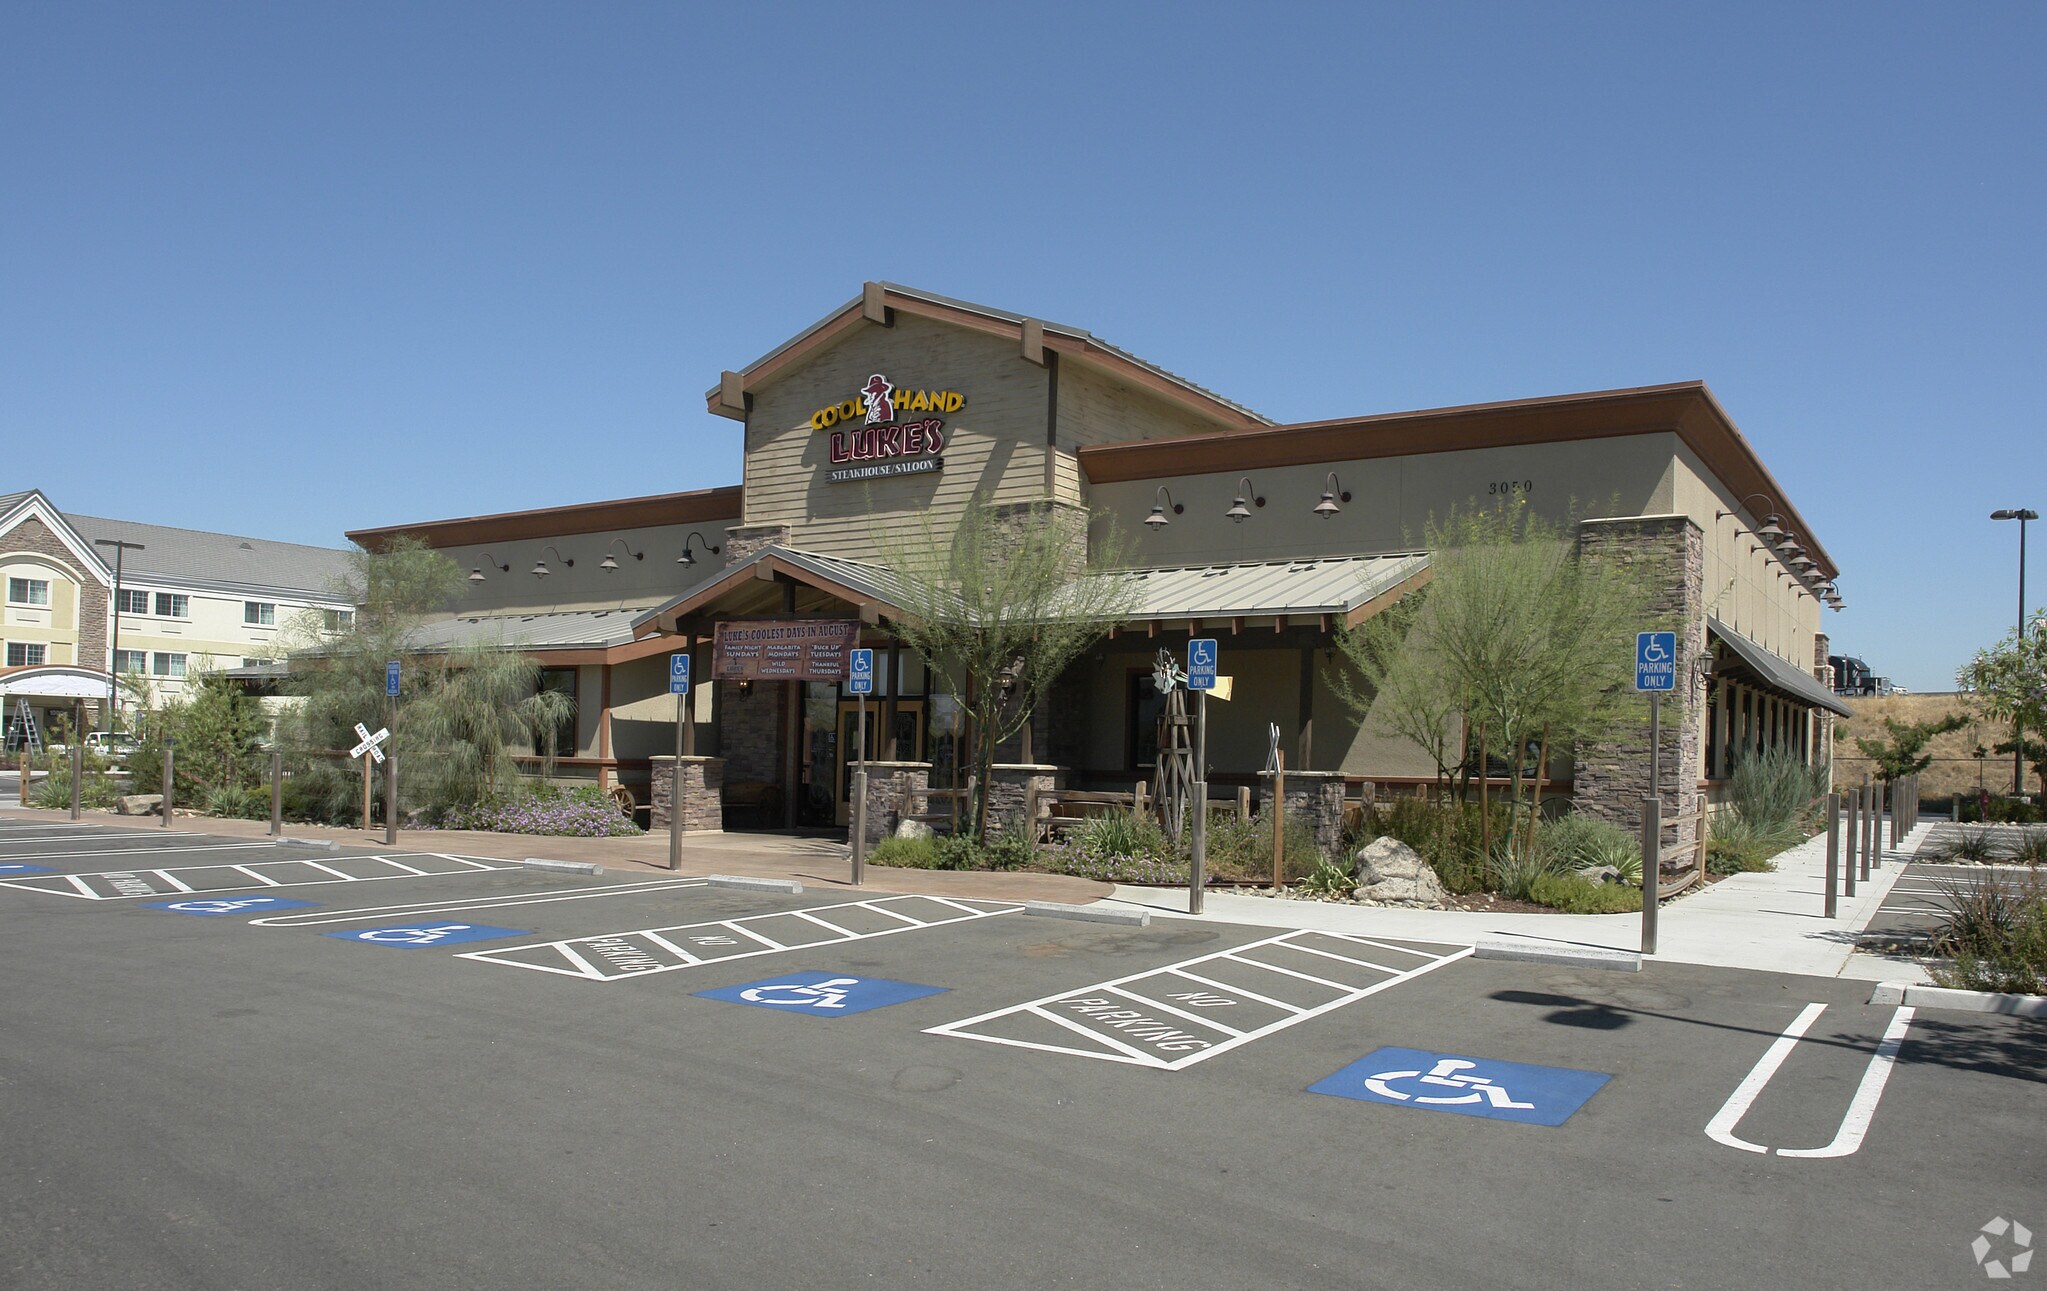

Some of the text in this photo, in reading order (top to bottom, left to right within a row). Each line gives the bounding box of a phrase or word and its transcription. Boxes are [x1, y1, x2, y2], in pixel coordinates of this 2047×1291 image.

[811, 389, 963, 430] COOL HAND
[831, 418, 945, 464] LUKE'S
[831, 460, 934, 480] STEAKHOUSE/SALOON
[1489, 480, 1532, 495] 3050
[724, 624, 849, 642] LUKE'S COOLEST DAYS IN AUGUST
[1190, 665, 1214, 675] PARKING
[1638, 662, 1672, 673] PARKING
[852, 672, 870, 680] PARKING
[1193, 676, 1209, 686] ONLY
[1644, 675, 1665, 687] ONLY
[854, 681, 867, 690] ONLY
[357, 725, 368, 739] RAIL
[355, 733, 384, 754] CROSSING
[689, 935, 738, 945] NO
[580, 937, 665, 971] PARKING
[1166, 992, 1237, 1006] NO
[1058, 998, 1212, 1051] PARKING
